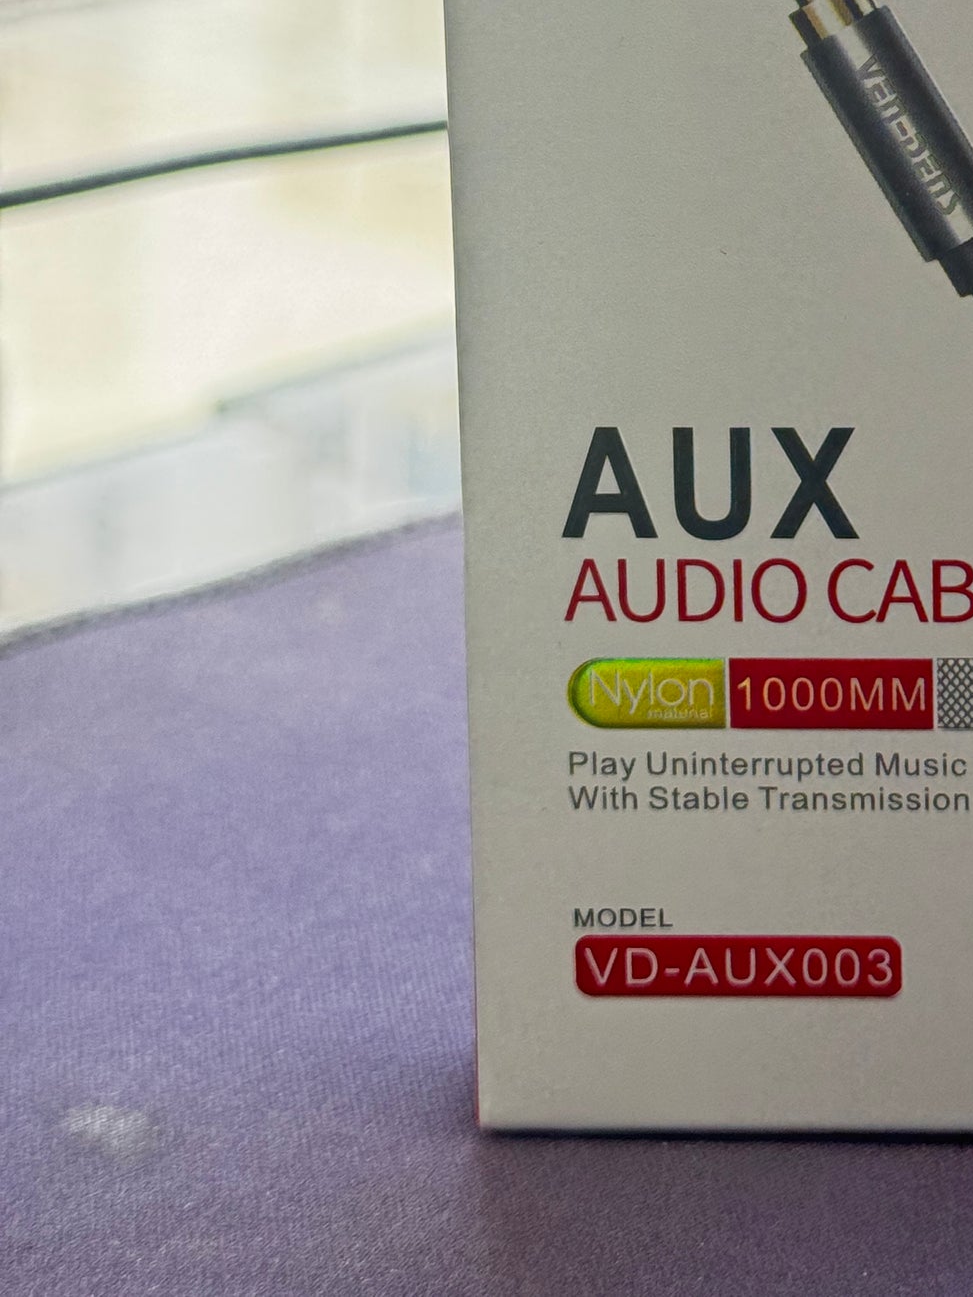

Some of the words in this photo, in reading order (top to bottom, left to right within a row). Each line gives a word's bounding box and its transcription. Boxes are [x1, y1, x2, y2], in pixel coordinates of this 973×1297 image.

[856, 53, 960, 215] VEN-DENS
[562, 427, 859, 540] AUX
[564, 558, 807, 623] AUDIO
[590, 669, 714, 715] Nylon
[737, 677, 926, 712] 1000MM
[568, 752, 636, 780] Play
[646, 752, 864, 781] Uninterrupted
[875, 752, 968, 777] Music
[568, 786, 638, 811] With
[649, 786, 749, 811] Stable
[758, 786, 970, 811] Transmission
[574, 908, 673, 928] MODEL
[584, 947, 893, 987] VD-AUX003
